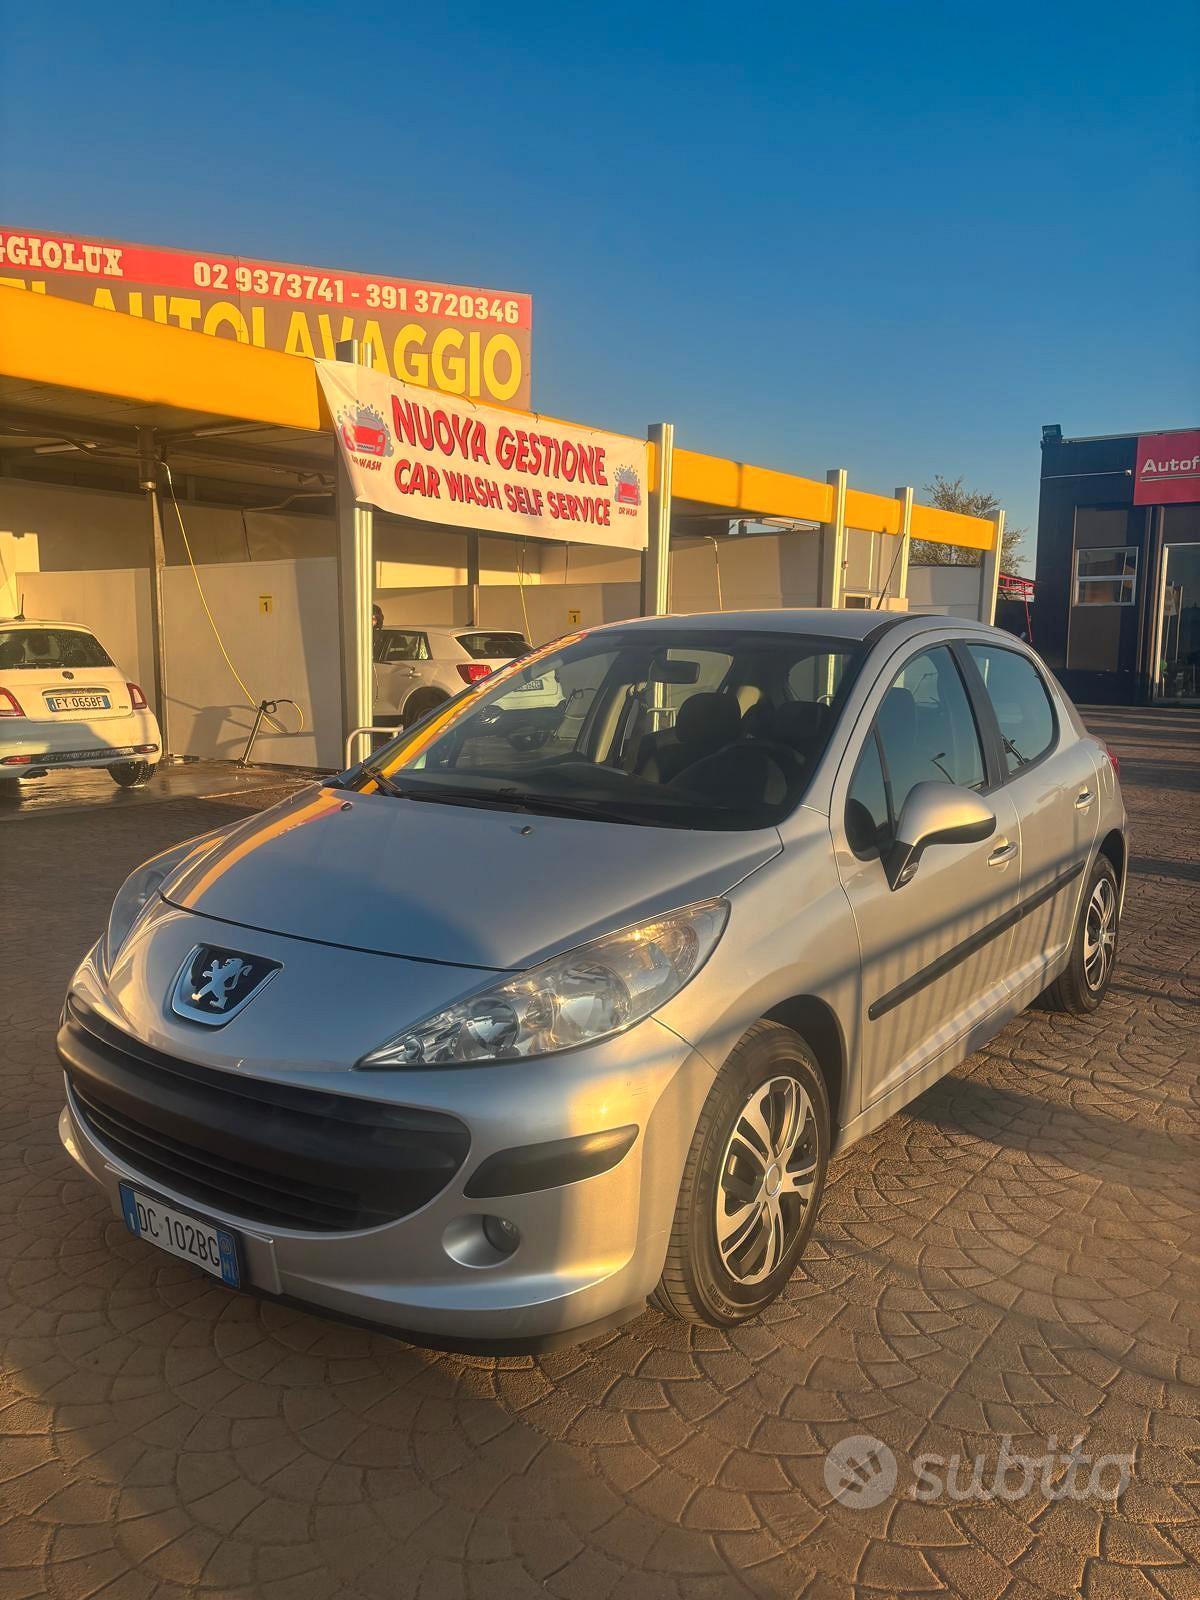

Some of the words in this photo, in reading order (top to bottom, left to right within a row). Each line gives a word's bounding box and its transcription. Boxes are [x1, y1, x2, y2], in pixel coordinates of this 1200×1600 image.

[0, 235, 123, 276] GIOLUX
[194, 261, 228, 290] 02
[235, 267, 344, 303] 9373741
[366, 283, 407, 311] 391
[414, 289, 519, 324] 3720346
[391, 394, 490, 465] NUOVA
[495, 426, 608, 486] GESTIONE
[359, 458, 382, 471] WASH
[1141, 456, 1200, 473] Autof
[394, 459, 441, 498] CAR
[442, 469, 503, 510] WASH
[504, 483, 543, 516] SELF
[546, 491, 611, 526] SERVICE
[263, 601, 269, 613] 1
[572, 614, 577, 624] 1
[56, 698, 69, 710] FY
[72, 696, 103, 709] 065BF
[136, 1202, 159, 1238] DC
[165, 1216, 220, 1267] 102BG
